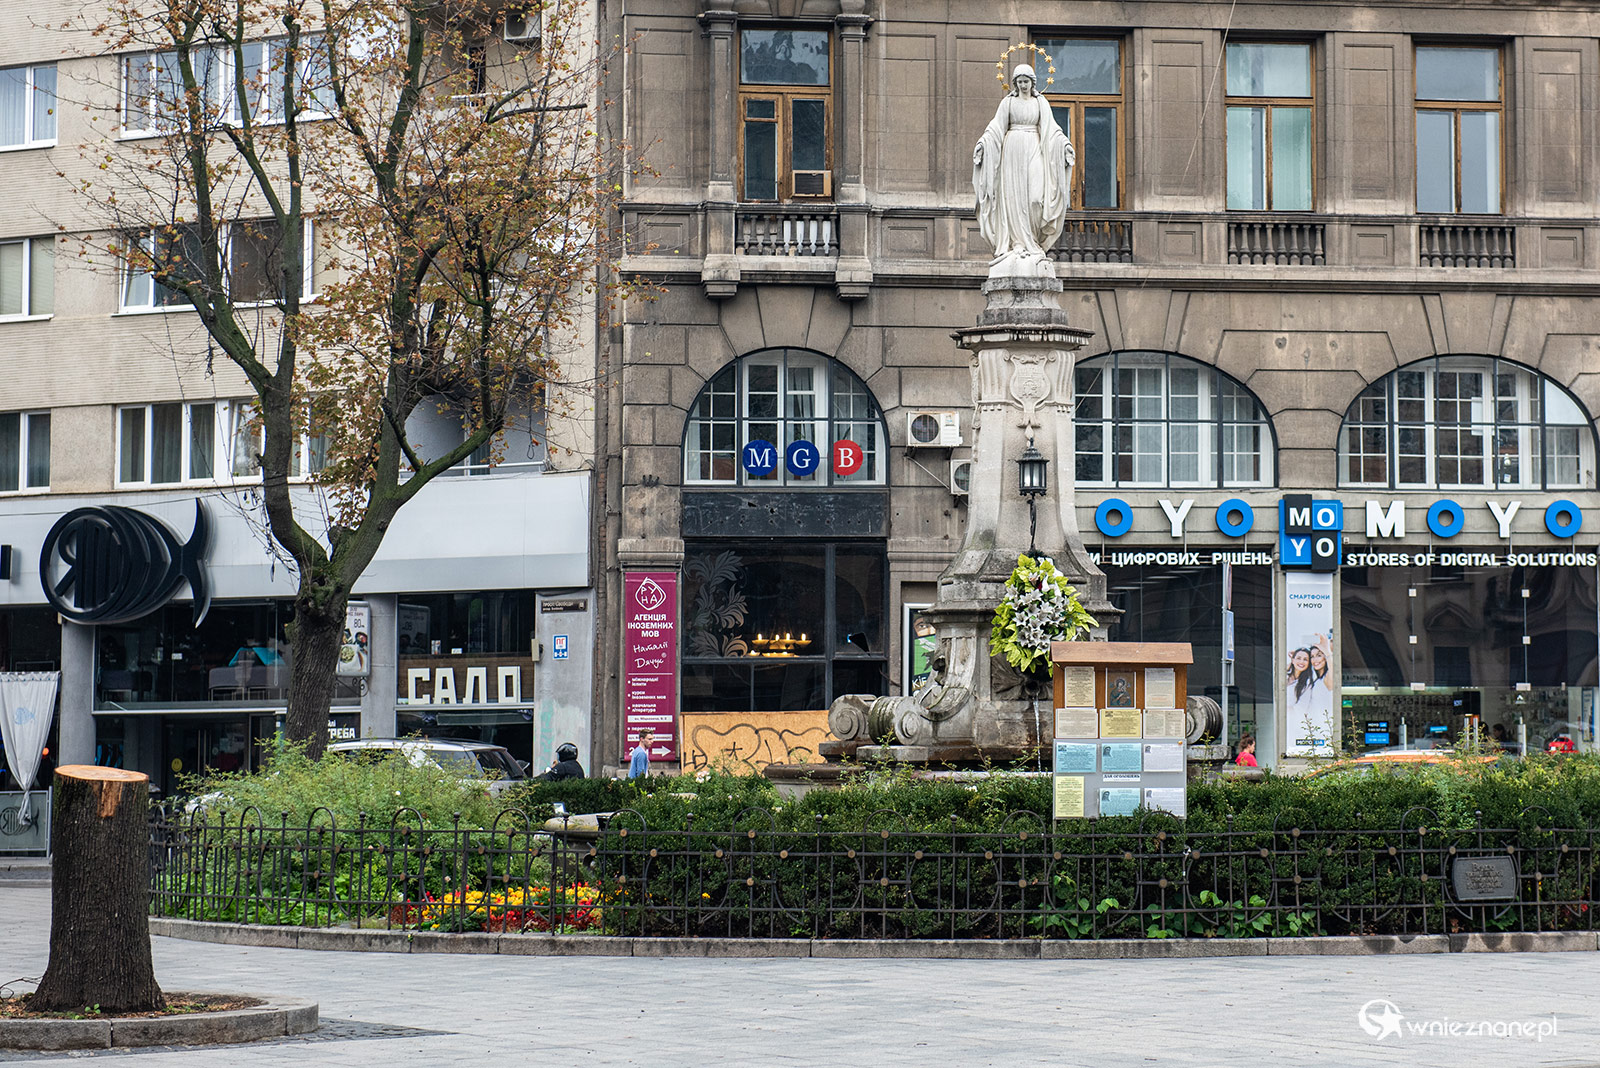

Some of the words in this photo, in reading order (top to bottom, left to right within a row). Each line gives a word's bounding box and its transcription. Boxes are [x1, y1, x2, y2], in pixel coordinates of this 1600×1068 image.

[1095, 498, 1254, 538] OYO
[1365, 499, 1583, 538] MOYO
[1111, 552, 1200, 567] ЦИФРОВИХ
[1212, 552, 1273, 566] РІШЕНЬ
[1346, 553, 1409, 566] STORES
[1414, 553, 1435, 566] OF
[1441, 553, 1500, 567] DIGITAL
[1507, 553, 1597, 567] SOLUTIONS
[634, 613, 667, 621] АГЕНЦІЯ
[641, 630, 660, 638] МОВ
[408, 667, 521, 705] САЛО
